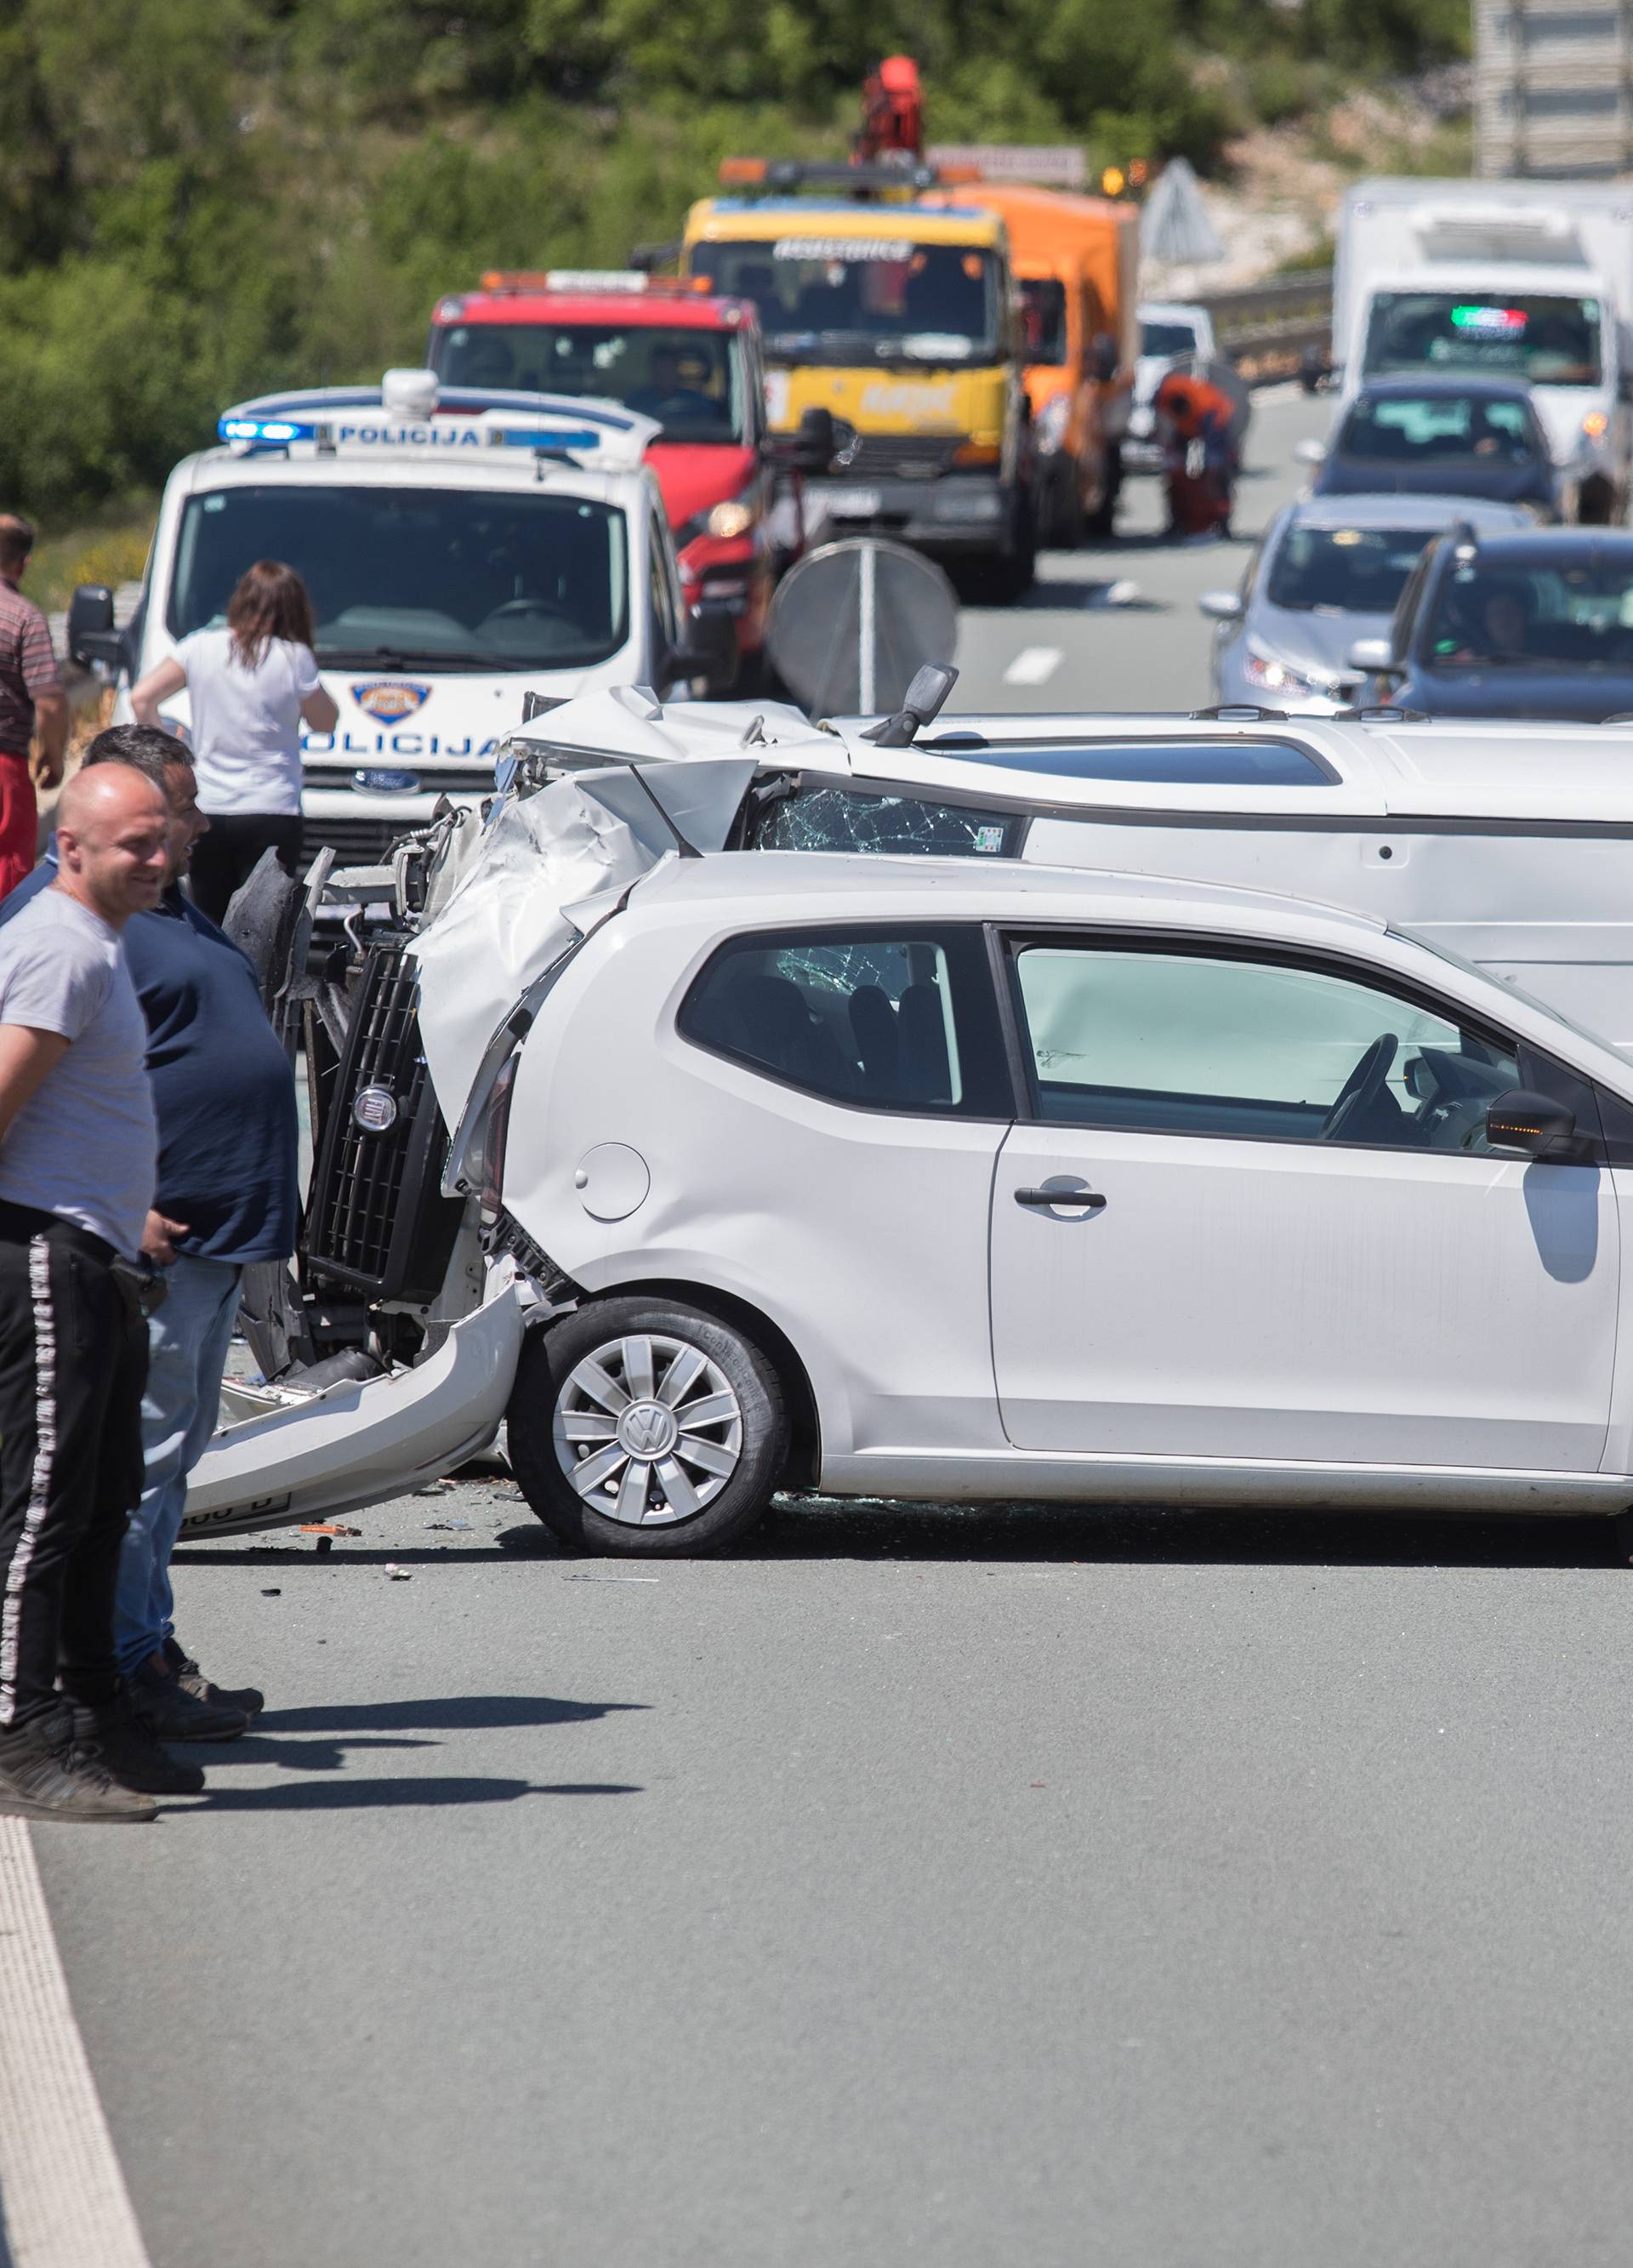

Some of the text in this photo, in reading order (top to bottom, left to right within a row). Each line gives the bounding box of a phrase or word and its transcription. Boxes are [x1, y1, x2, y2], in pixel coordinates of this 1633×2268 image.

[340, 426, 478, 447] POLICIJA
[300, 732, 500, 756] OLICIJA
[364, 1097, 385, 1125] FIAT
